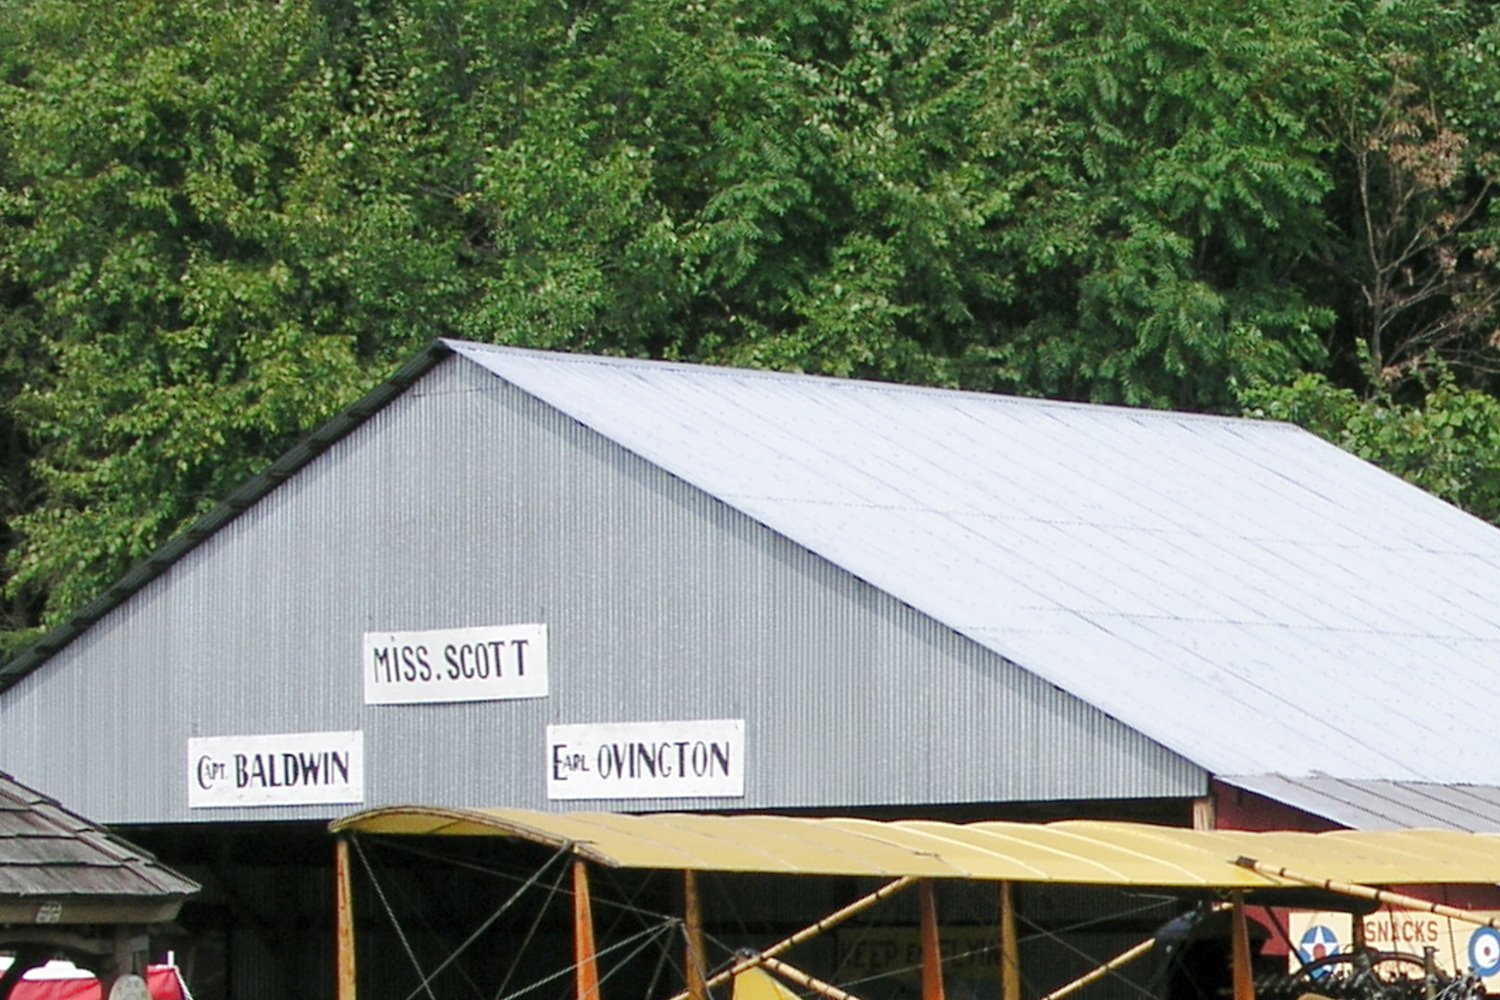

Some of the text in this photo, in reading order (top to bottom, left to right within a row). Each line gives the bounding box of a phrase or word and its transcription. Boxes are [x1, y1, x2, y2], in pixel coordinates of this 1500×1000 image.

[373, 639, 529, 684] MISS. SCOTT
[234, 751, 349, 789] BALDWIN
[597, 740, 730, 780] OVINGTON
[1365, 920, 1438, 943] SNACKS
